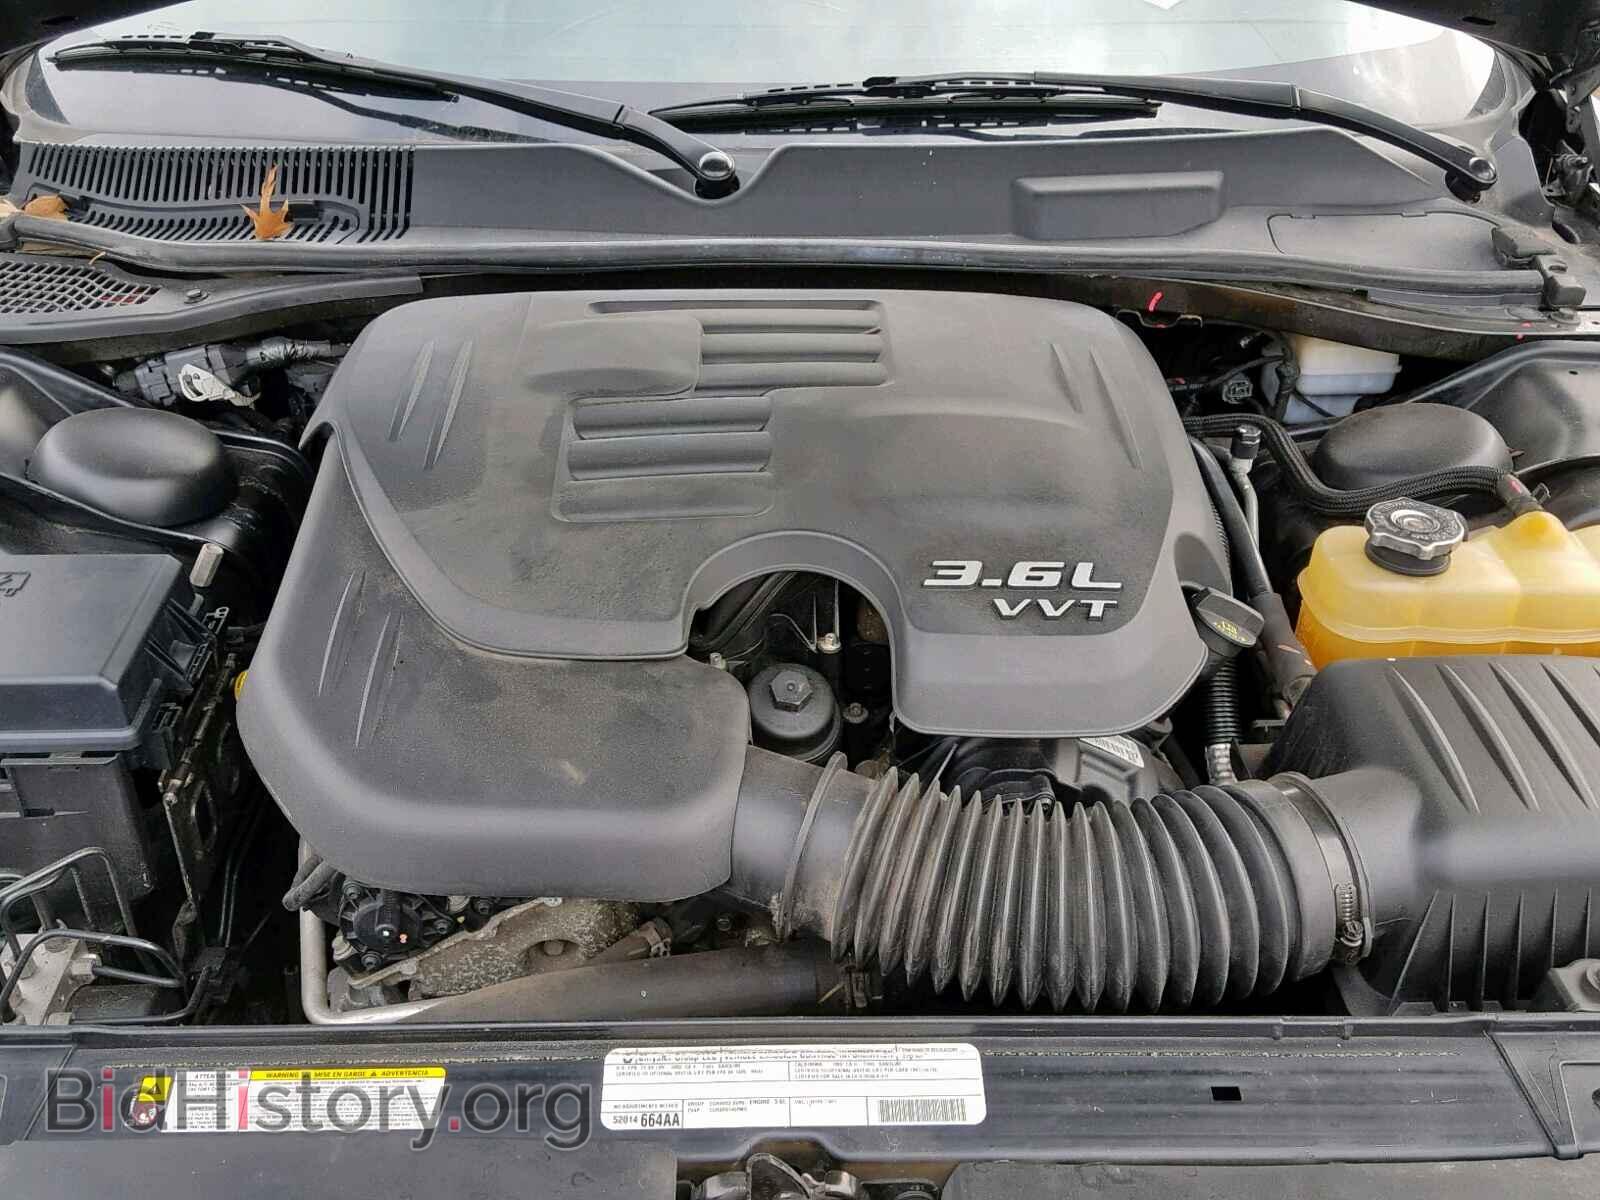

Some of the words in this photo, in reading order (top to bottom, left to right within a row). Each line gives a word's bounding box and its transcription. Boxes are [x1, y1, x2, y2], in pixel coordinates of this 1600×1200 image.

[922, 560, 1123, 590] 3.6L
[991, 598, 1118, 621] VVT
[265, 1071, 300, 1079] WARNING
[640, 1112, 680, 1128] 664AA
